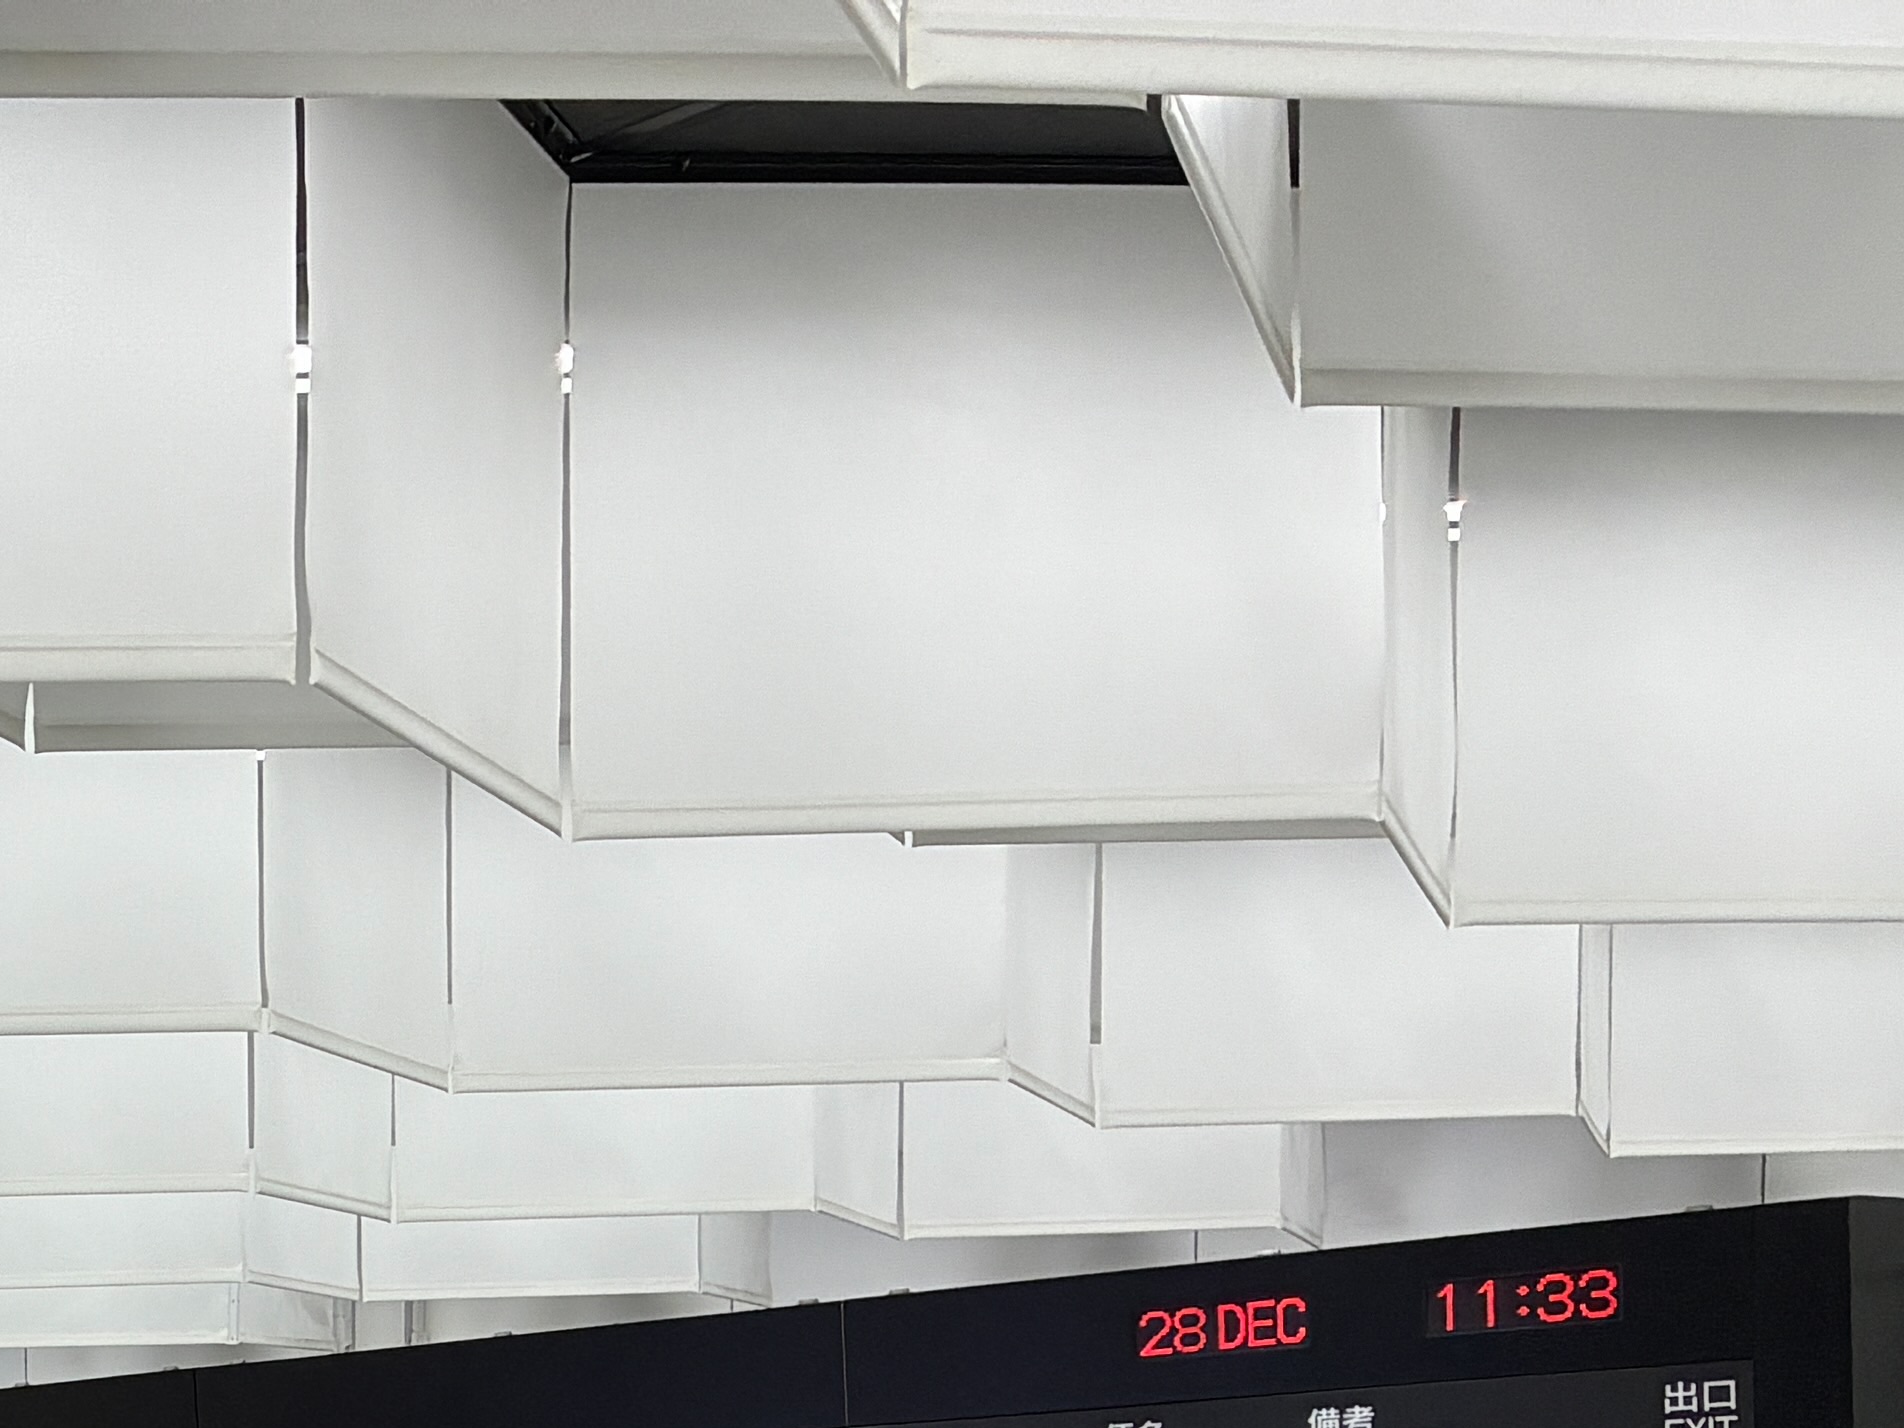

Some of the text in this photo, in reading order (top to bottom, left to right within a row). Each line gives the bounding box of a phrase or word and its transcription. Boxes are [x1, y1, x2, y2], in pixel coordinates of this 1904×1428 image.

[1140, 1268, 1619, 1358] 28 DEC 11:33
[1665, 1380, 1737, 1411] 出口
